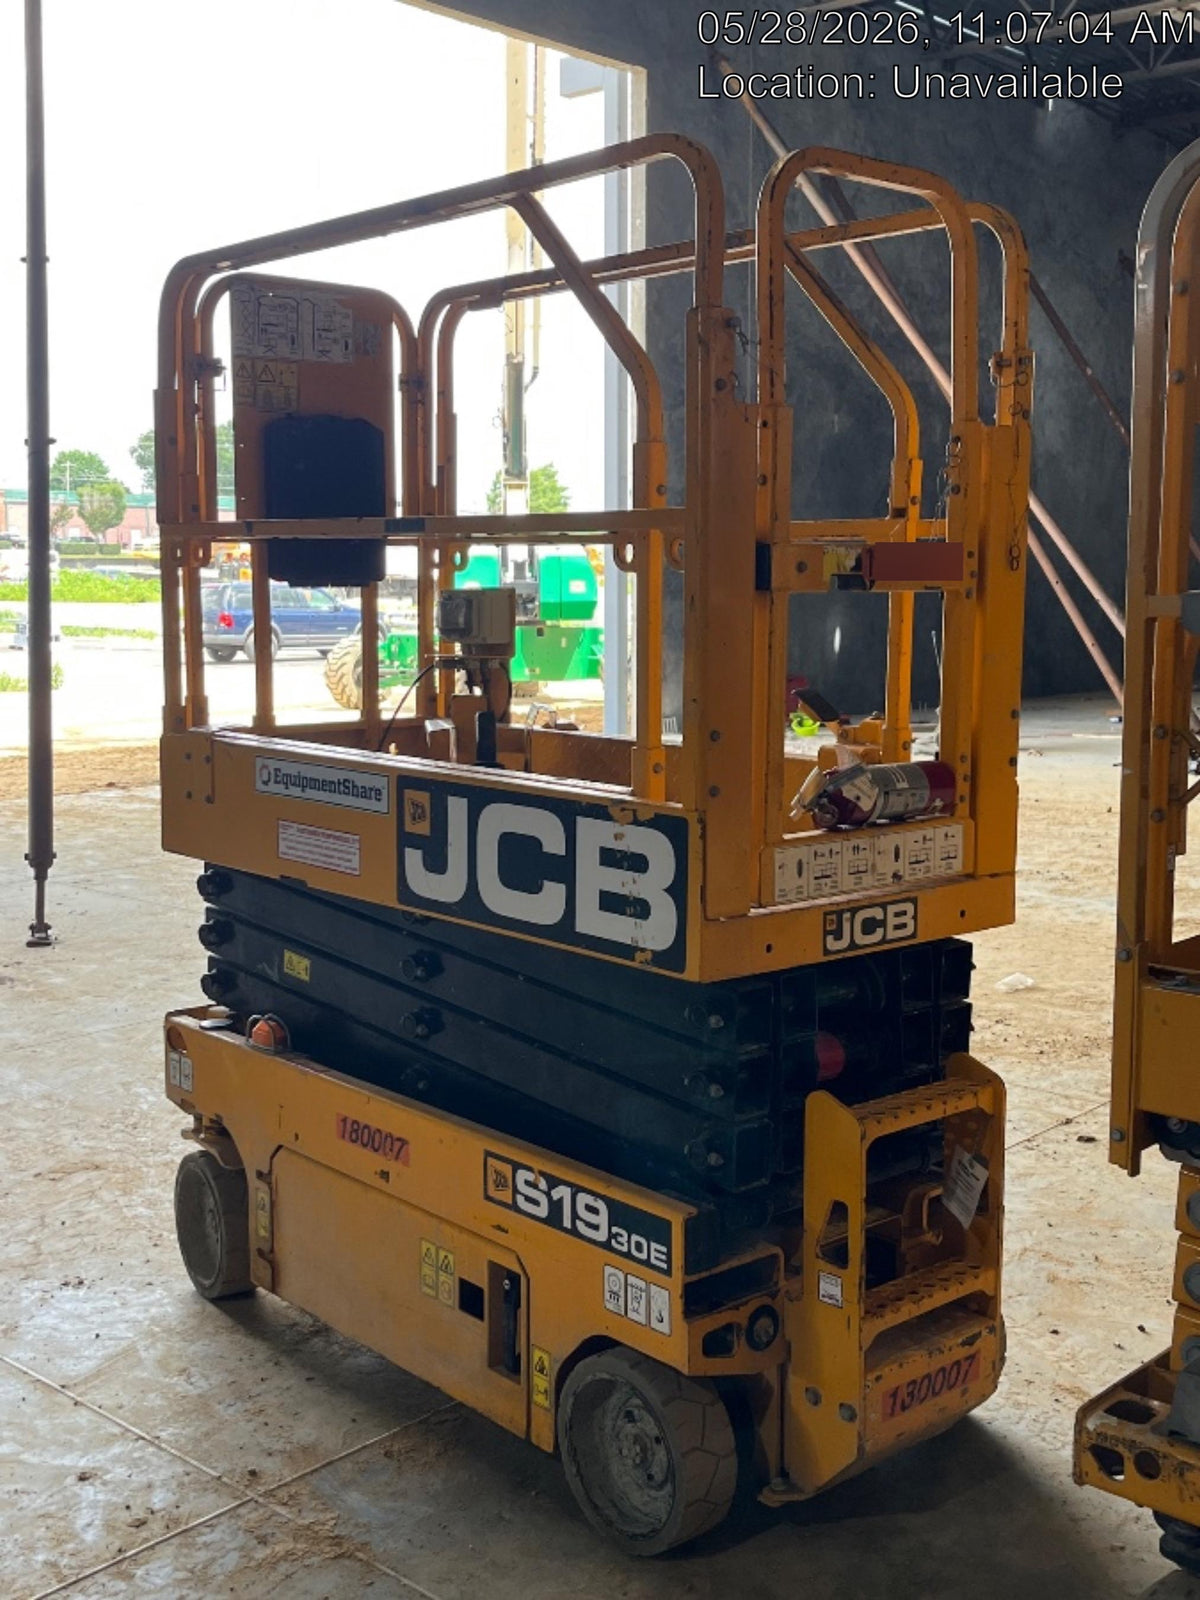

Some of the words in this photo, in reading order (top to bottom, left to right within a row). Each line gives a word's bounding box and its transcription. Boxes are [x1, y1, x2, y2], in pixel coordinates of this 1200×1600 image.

[273, 767, 382, 802] EquipmentShare
[404, 794, 677, 951] JCB
[826, 902, 916, 951] JCB
